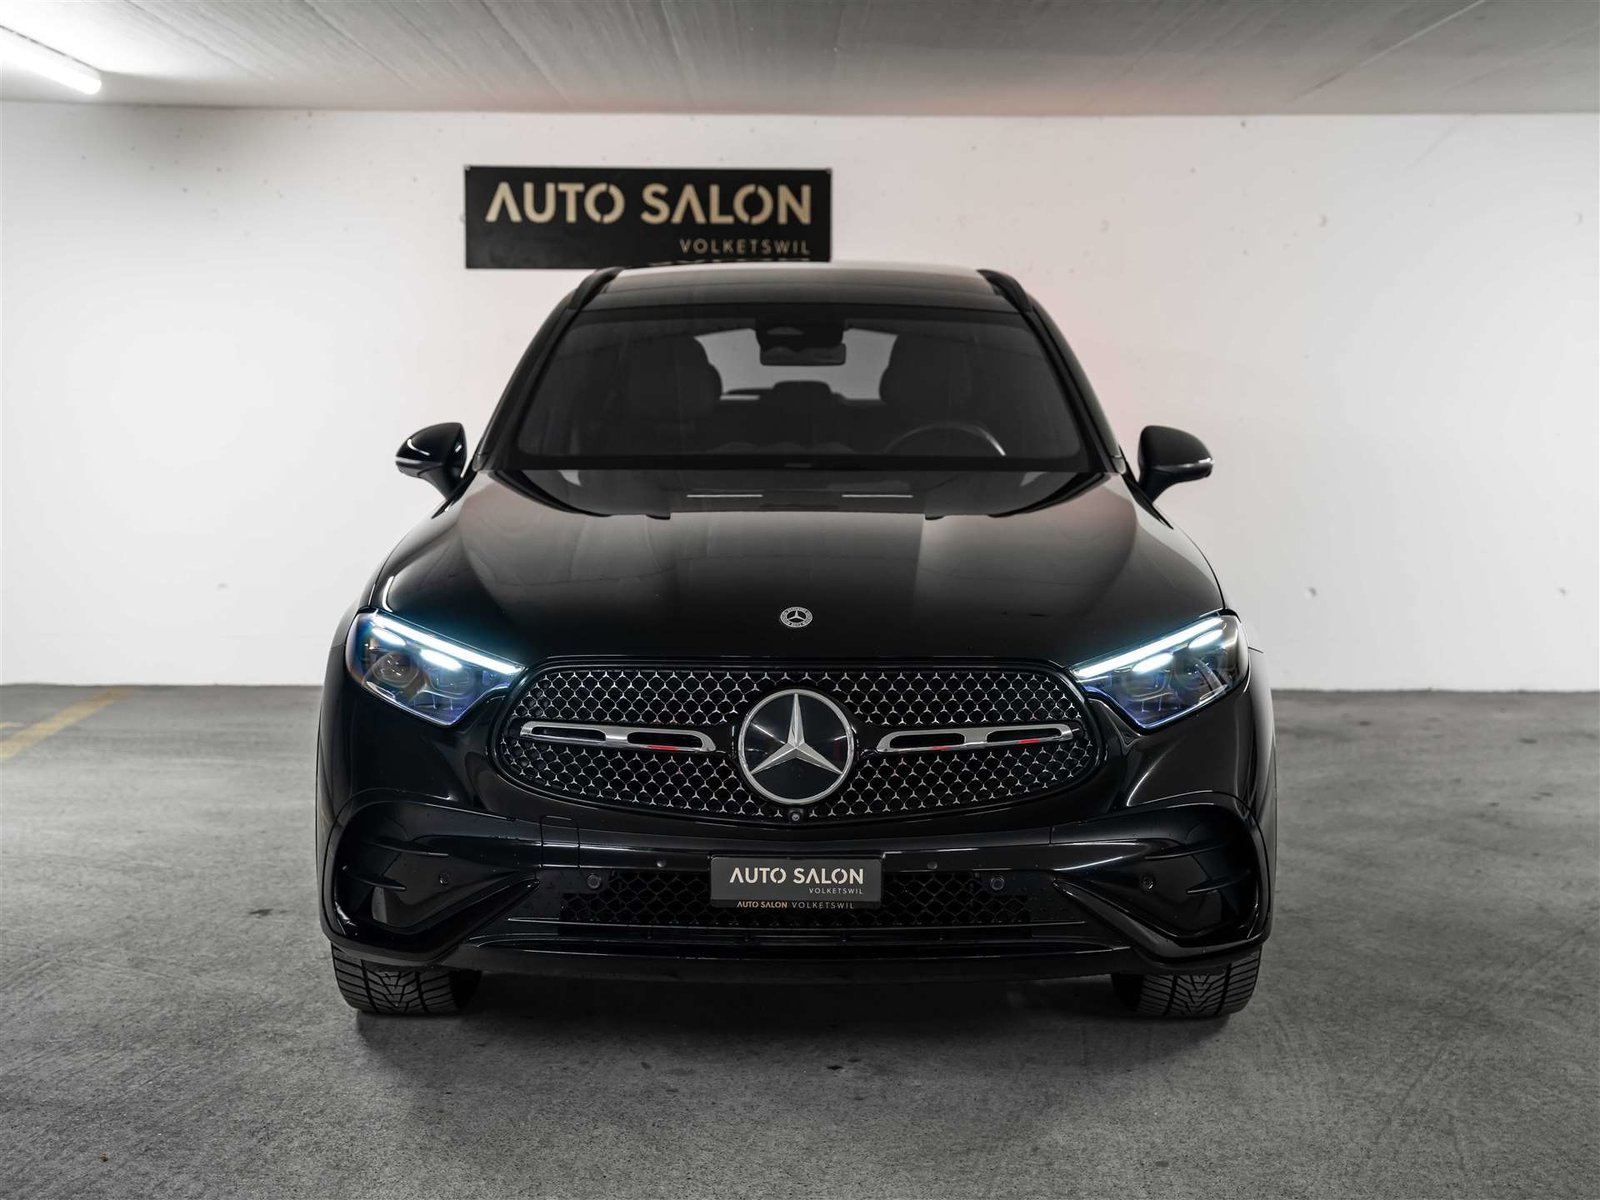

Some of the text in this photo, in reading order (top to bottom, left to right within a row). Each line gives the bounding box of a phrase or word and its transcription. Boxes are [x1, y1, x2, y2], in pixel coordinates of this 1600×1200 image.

[485, 181, 811, 225] AUTO SALON
[679, 238, 811, 256] VOLKETSWIL
[729, 867, 864, 885] AUTO SALON
[808, 887, 864, 895] VOLKETSWIL
[736, 901, 855, 910] AUTO SALON VOLKETSWIL
